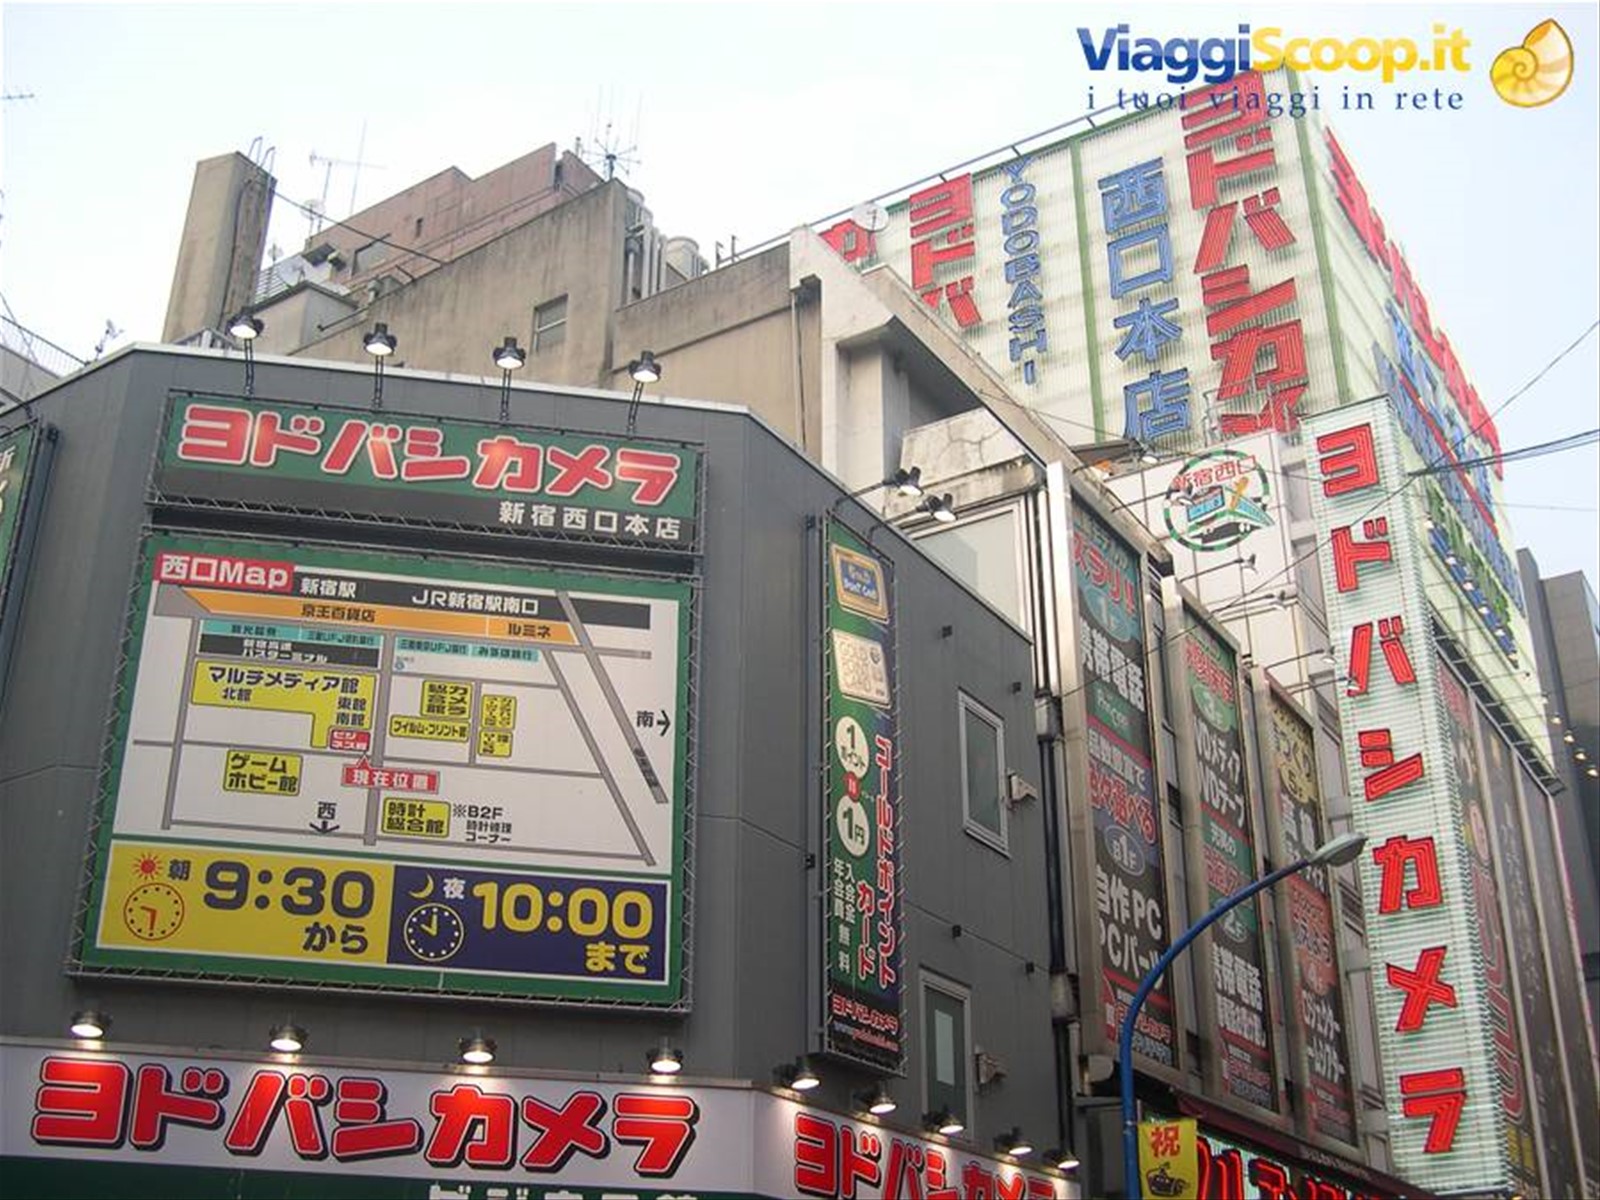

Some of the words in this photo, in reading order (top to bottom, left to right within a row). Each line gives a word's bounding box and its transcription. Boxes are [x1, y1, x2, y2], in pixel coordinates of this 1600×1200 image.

[1000, 157, 1047, 385] YODOBASHI
[1098, 156, 1191, 441] 西口本店
[177, 403, 682, 506] ヨドバシカメラ
[499, 500, 681, 541] 新宿西口本店
[161, 554, 288, 588] 西口Map
[301, 577, 356, 599] 新宿駅
[412, 588, 539, 616] JR新宿駅南口
[301, 604, 376, 623] 京王百貨店
[508, 622, 551, 639] ルミネ
[208, 666, 360, 695] マルチメディア館
[222, 686, 252, 702] 北館
[337, 695, 367, 711] 東館
[636, 710, 654, 728] 南
[229, 753, 287, 774] ゲーム
[228, 771, 299, 794] ホビー館
[351, 769, 431, 789] 現在位置
[1316, 423, 1468, 1155] ヨドバシカメラ
[317, 801, 336, 820] 西
[387, 802, 426, 818] 時計
[386, 816, 445, 834] 総合館
[465, 832, 512, 844] コーナー
[1111, 833, 1138, 869] B1F
[168, 859, 191, 882] 朝
[202, 861, 375, 919] 9:30
[443, 877, 466, 900] 夜
[472, 881, 653, 939] 10:00
[303, 922, 370, 955] から
[857, 880, 876, 981] カード
[583, 941, 649, 974] まで
[31, 1056, 701, 1177] ヨドバシカメラ
[1150, 1125, 1182, 1159] 祝
